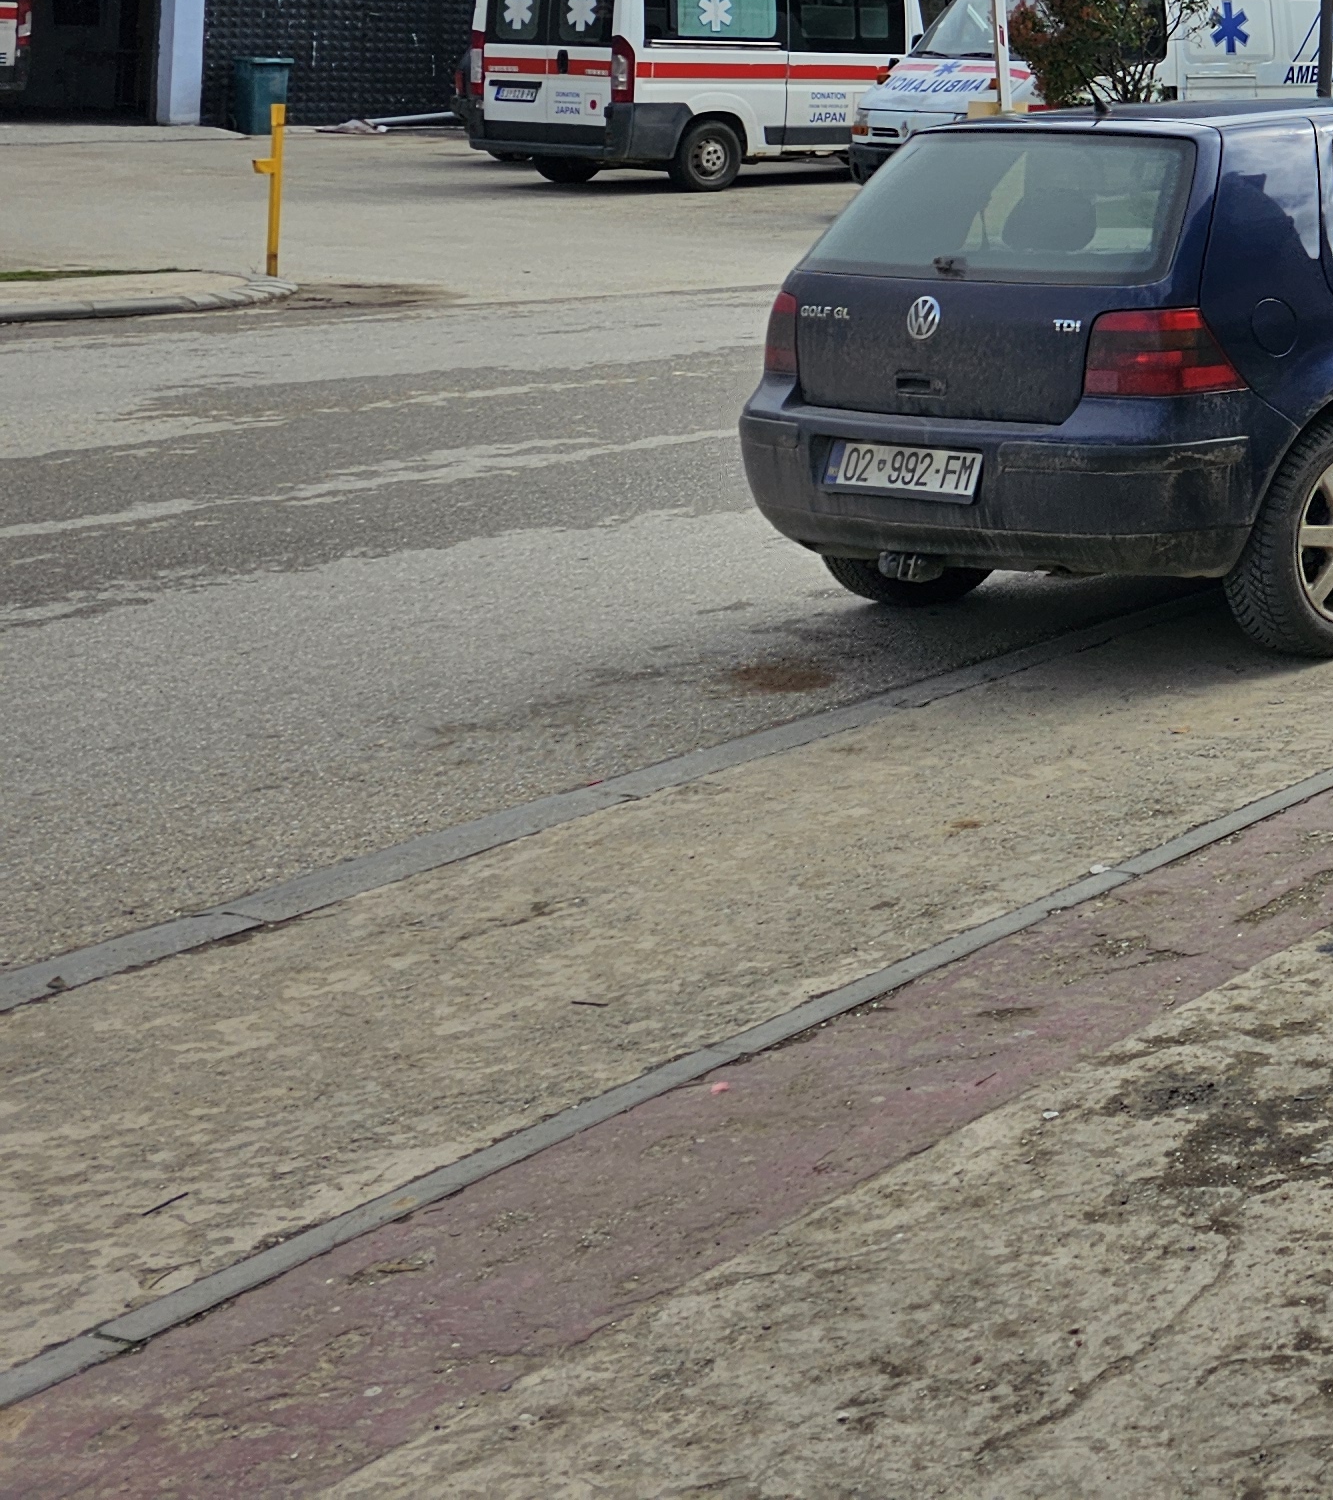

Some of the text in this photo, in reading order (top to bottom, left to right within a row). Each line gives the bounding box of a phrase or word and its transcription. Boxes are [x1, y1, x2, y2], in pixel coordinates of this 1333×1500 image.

[811, 92, 846, 100] DONATION
[555, 106, 580, 115] JAPAN
[809, 112, 846, 123] JAPAN
[800, 305, 850, 319] GOLF GL
[1053, 318, 1082, 333] TDI
